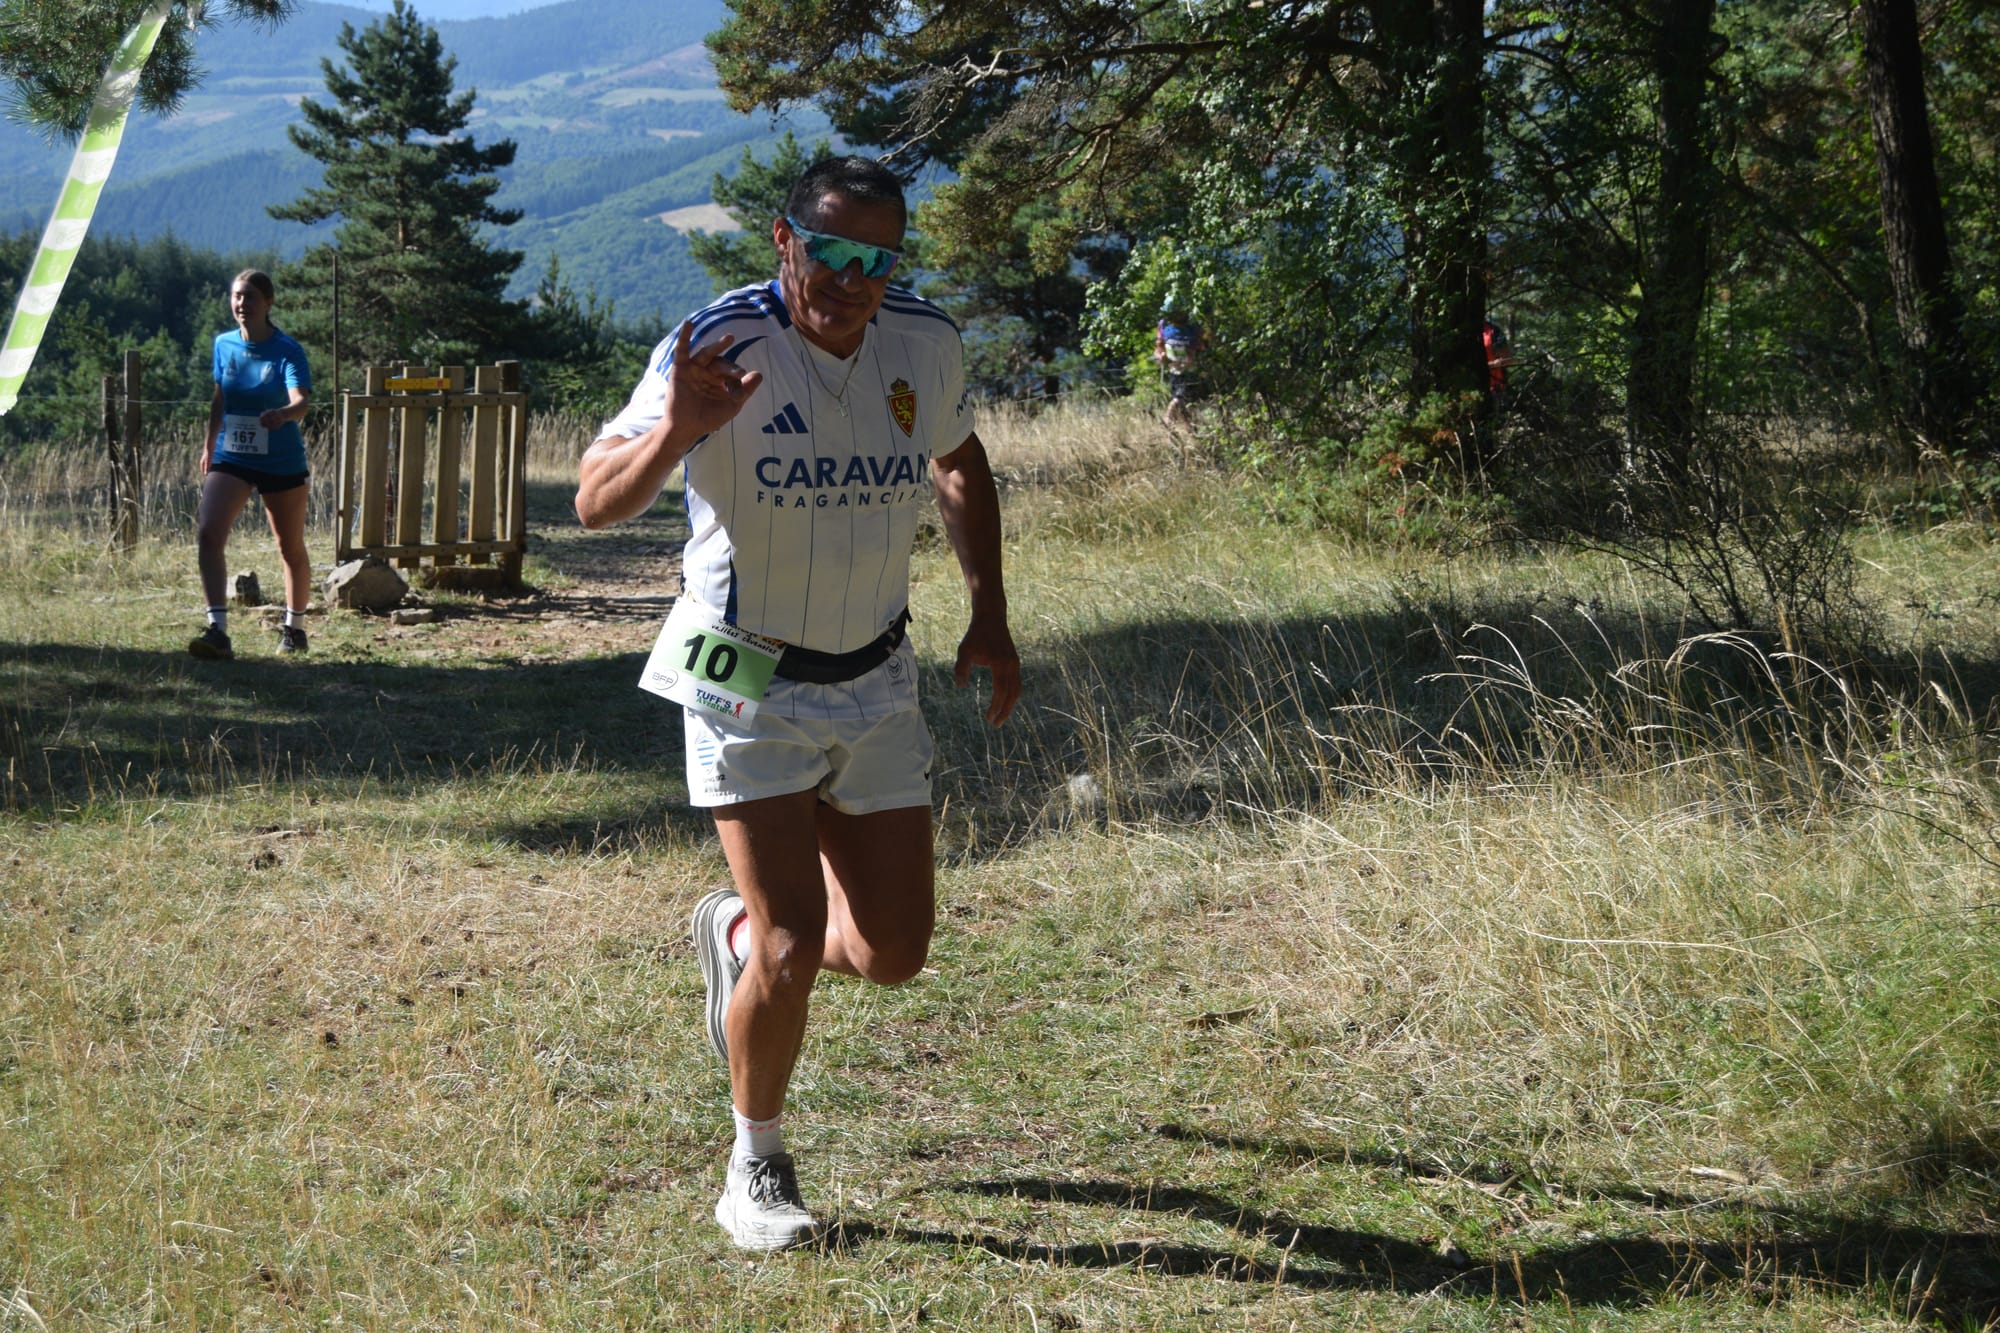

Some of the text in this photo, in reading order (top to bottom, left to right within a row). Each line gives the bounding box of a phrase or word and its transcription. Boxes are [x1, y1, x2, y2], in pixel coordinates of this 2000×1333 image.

[232, 430, 256, 444] 167
[683, 634, 738, 683] 10
[696, 688, 732, 709] TUFF'S
[696, 696, 734, 716] Aventure
